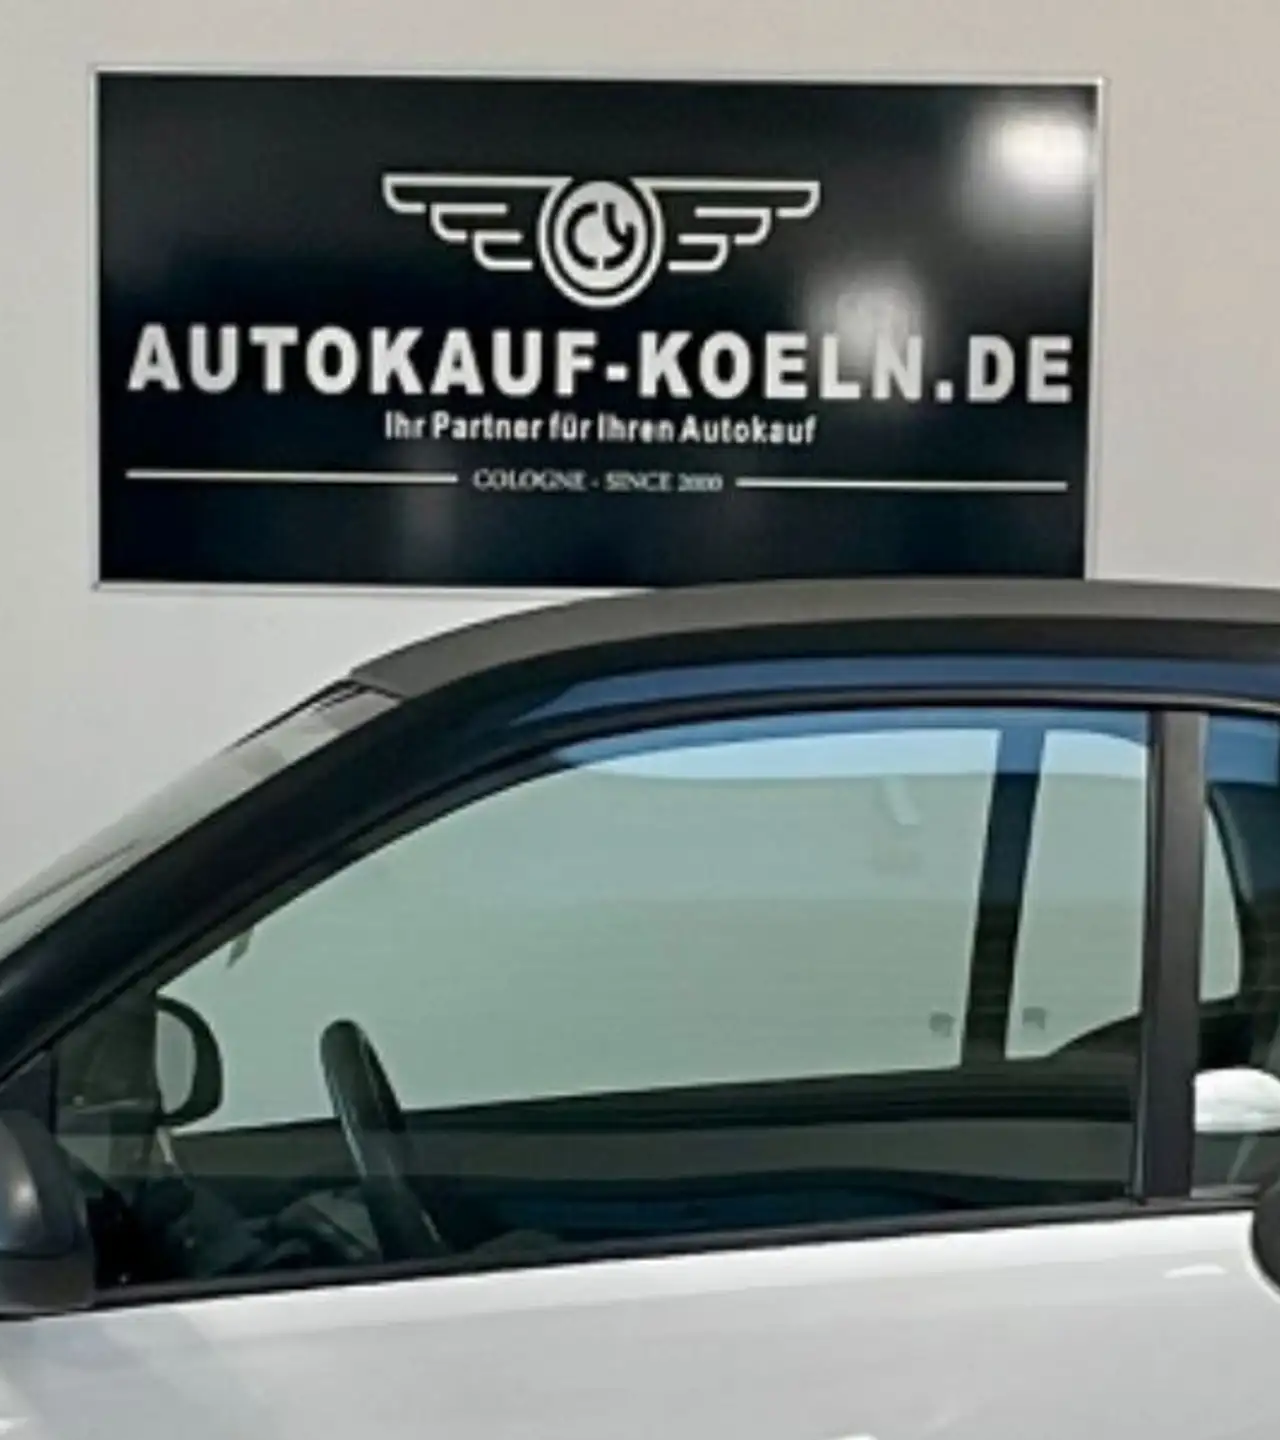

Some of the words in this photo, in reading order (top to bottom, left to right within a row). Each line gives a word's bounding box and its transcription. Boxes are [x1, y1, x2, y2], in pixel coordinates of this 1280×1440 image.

[127, 323, 1074, 403] AUTOKAUF-KOELN.DE
[384, 411, 424, 441] Ihr
[431, 411, 544, 441] Partner
[548, 411, 592, 442] für
[598, 413, 675, 443] Ihren
[679, 413, 819, 445] Autokauf
[472, 468, 587, 492] COLOGNE
[604, 469, 673, 493] SINCE
